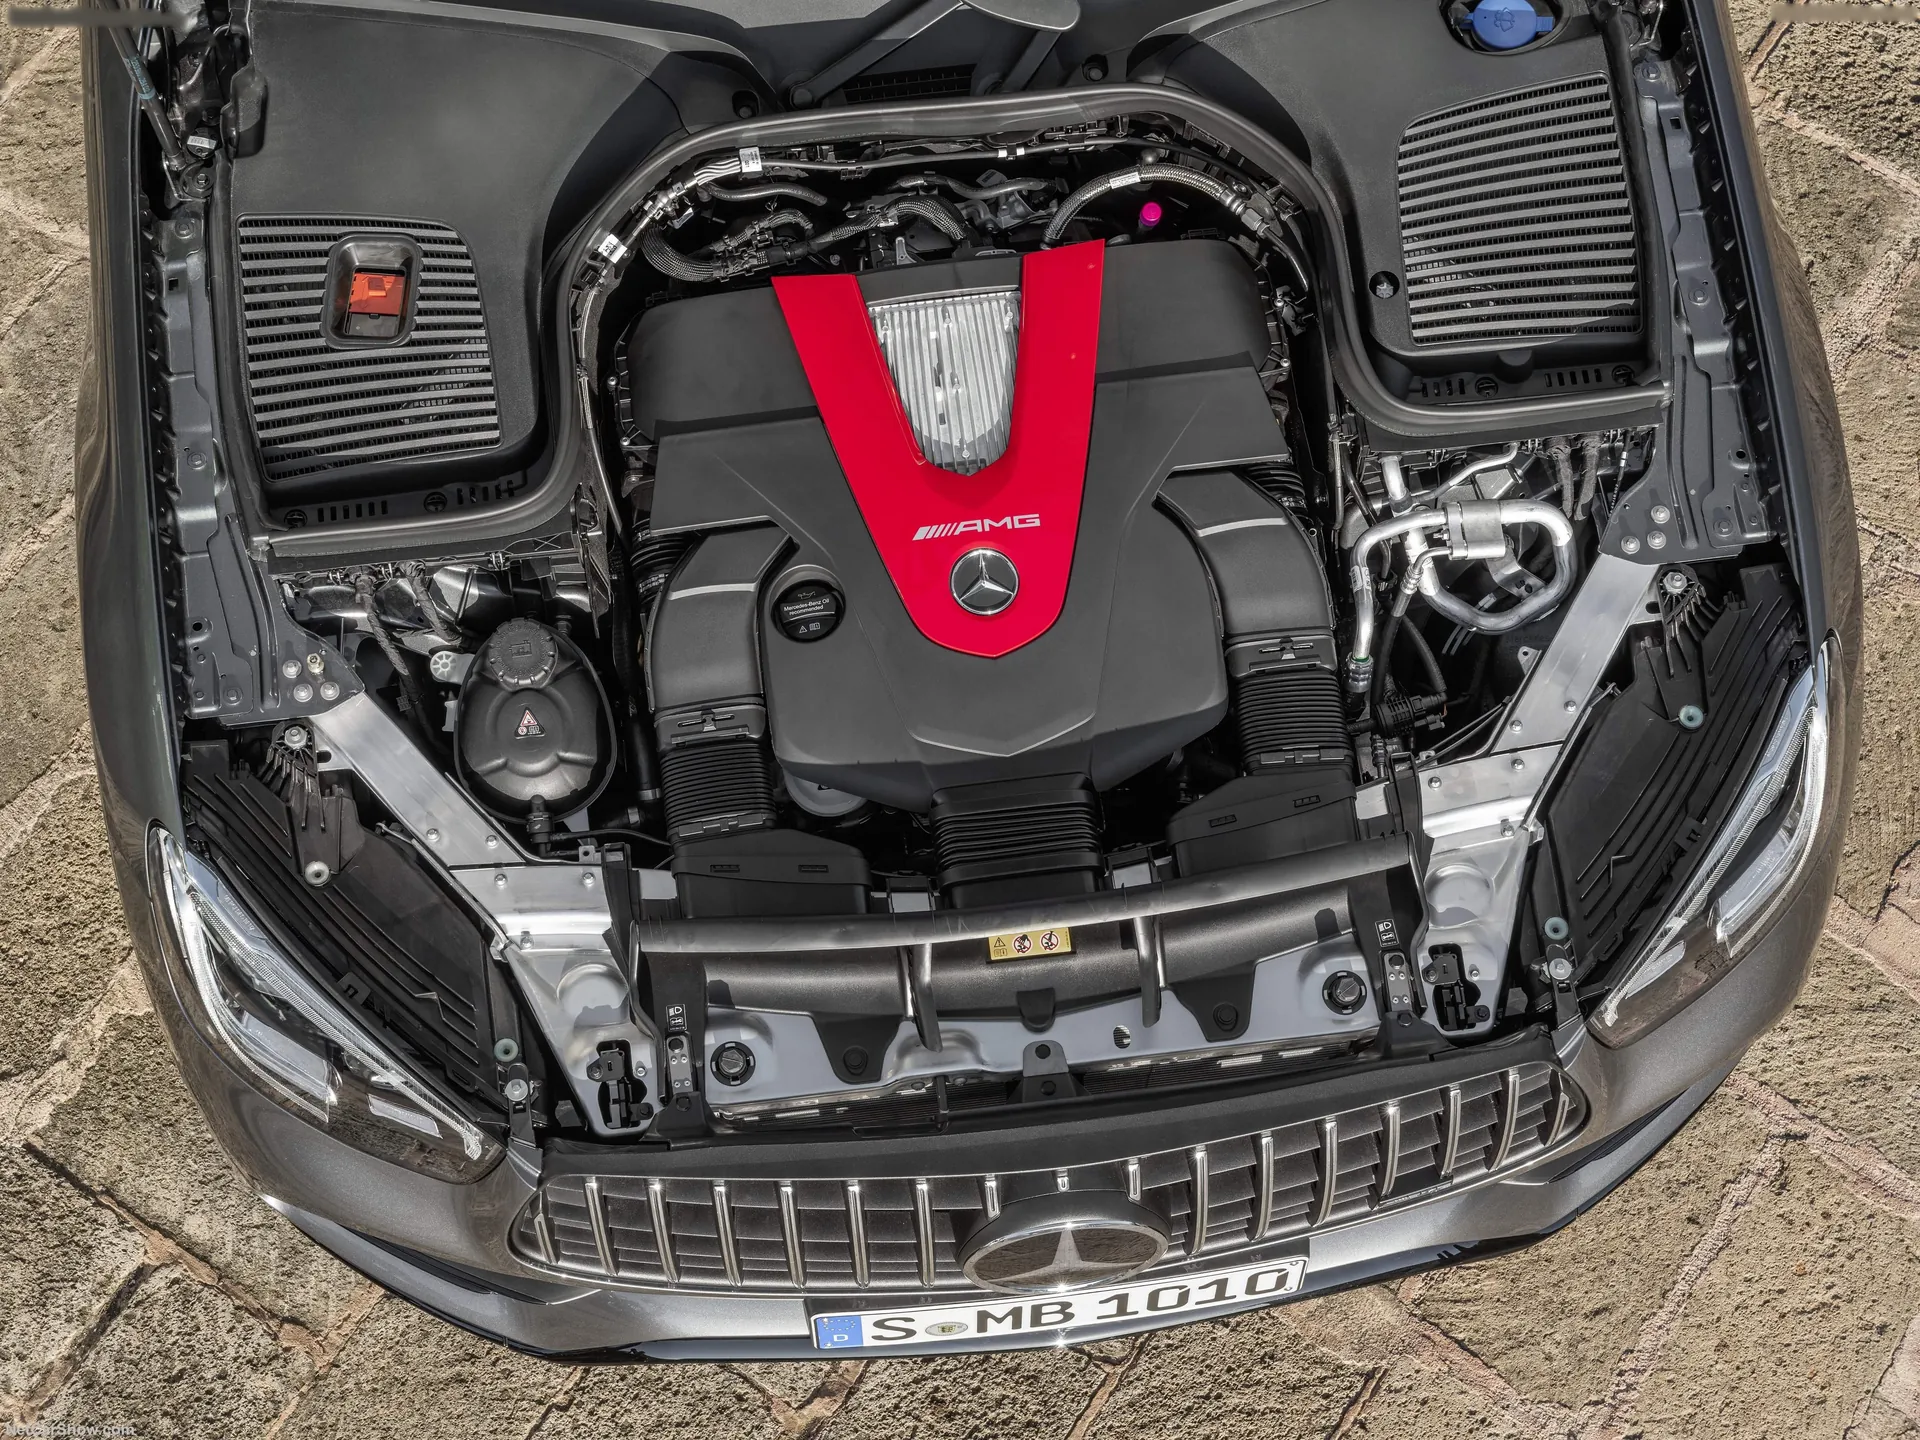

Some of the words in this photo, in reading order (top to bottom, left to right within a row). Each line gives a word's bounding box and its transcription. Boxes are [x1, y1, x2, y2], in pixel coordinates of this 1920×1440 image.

[953, 513, 1041, 536] AMG
[784, 600, 821, 611] Mercedes-Benz
[789, 605, 823, 615] recommended
[872, 1317, 917, 1341] S
[977, 1302, 1075, 1334] MB
[1097, 1269, 1290, 1319] 1010
[833, 1334, 849, 1342] D
